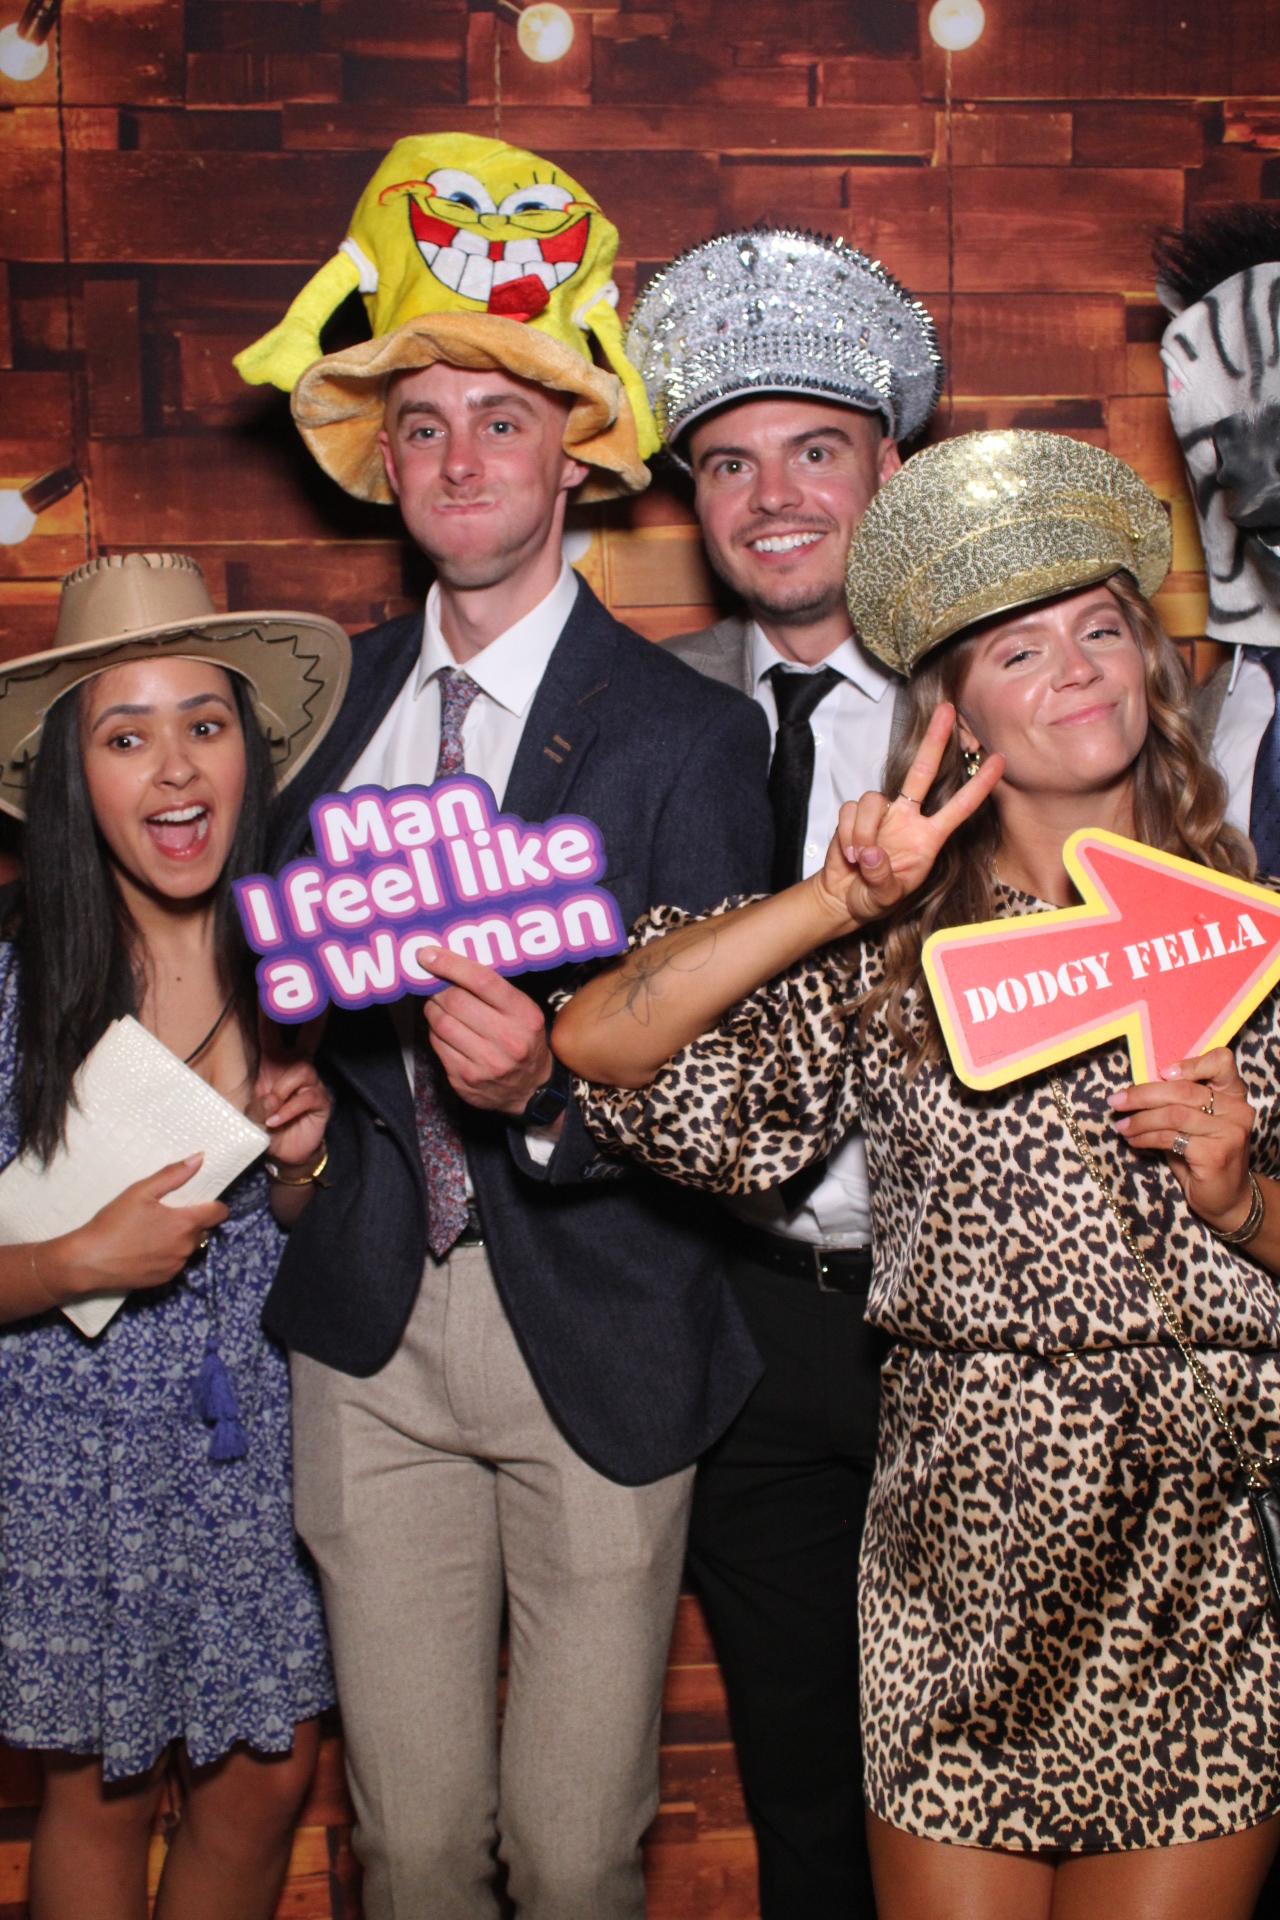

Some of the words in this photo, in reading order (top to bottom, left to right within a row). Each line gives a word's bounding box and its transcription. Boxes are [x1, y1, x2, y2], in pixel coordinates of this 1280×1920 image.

[323, 788, 486, 862] Man
[247, 888, 277, 942] I
[290, 848, 440, 933] feel
[451, 829, 593, 897] like
[268, 964, 315, 1010] a
[963, 952, 1114, 1025] DODGY
[1122, 913, 1267, 980] FELLA
